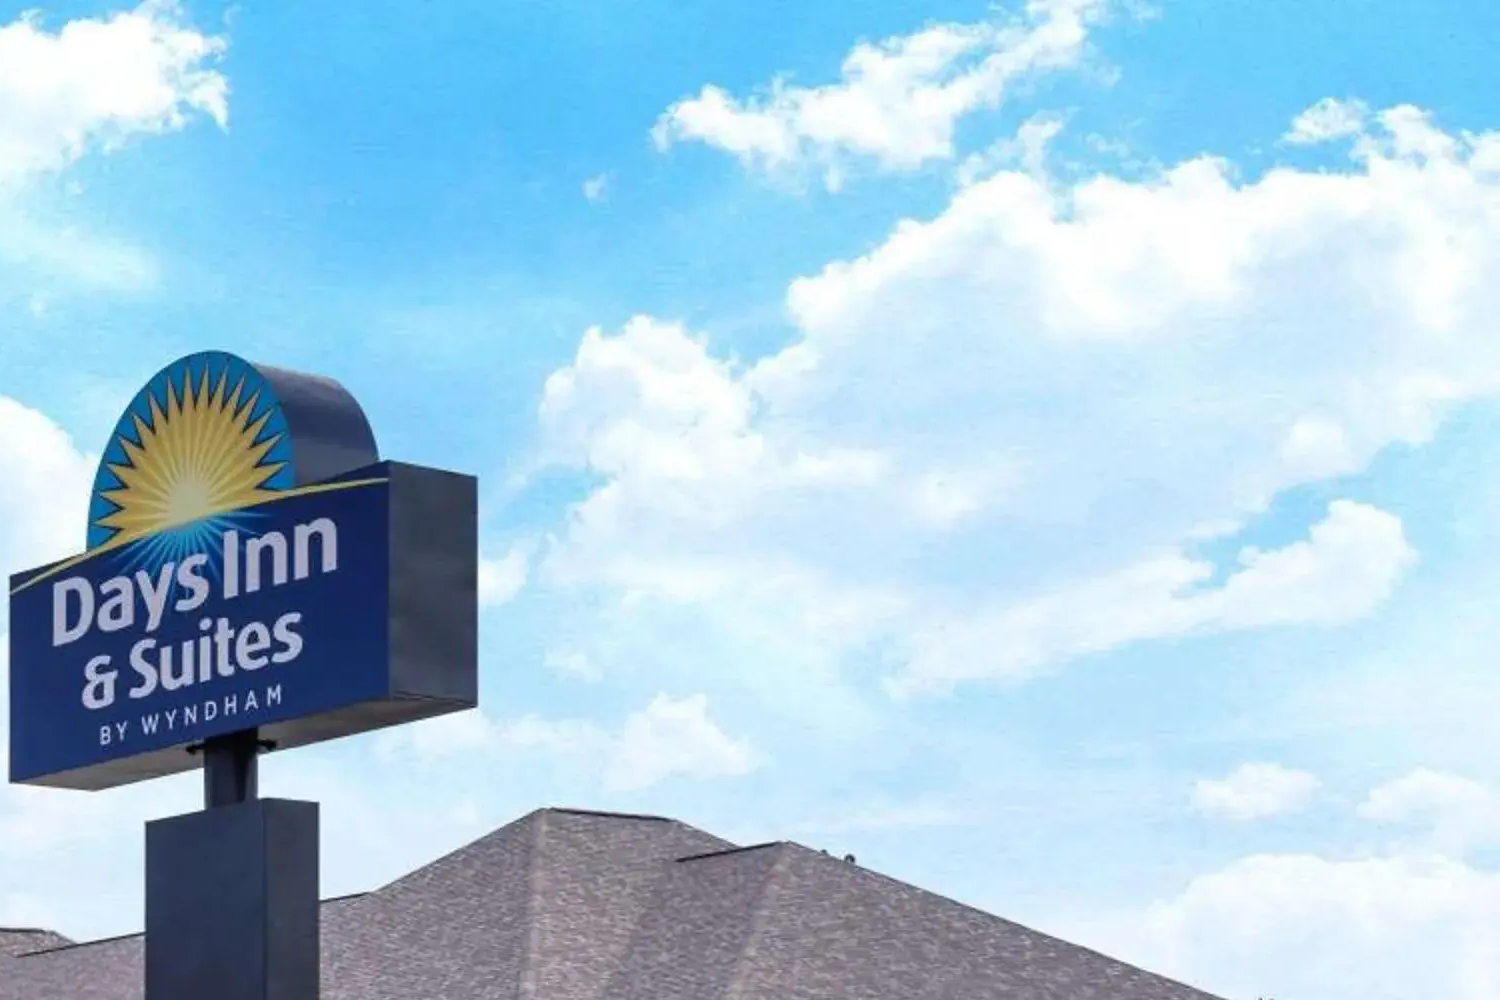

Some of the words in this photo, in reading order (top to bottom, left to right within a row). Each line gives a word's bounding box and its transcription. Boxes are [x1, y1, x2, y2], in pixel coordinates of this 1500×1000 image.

[52, 552, 210, 648] Days
[222, 516, 339, 601] Inn
[81, 653, 118, 711] &
[128, 612, 304, 701] Suites
[99, 719, 128, 746] BY
[142, 684, 284, 737] WYNDHAM
